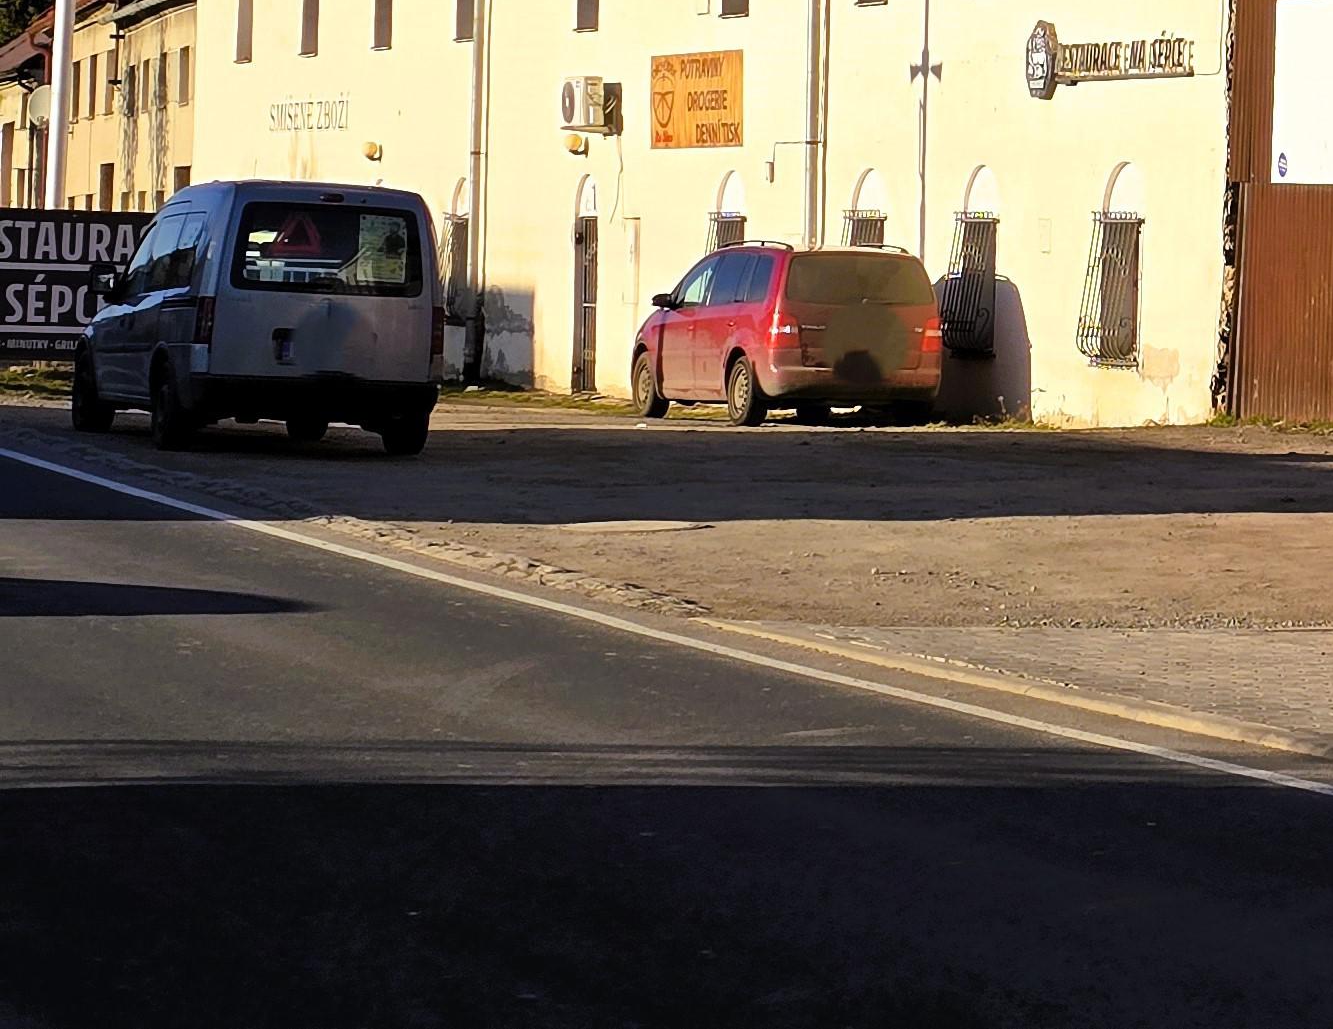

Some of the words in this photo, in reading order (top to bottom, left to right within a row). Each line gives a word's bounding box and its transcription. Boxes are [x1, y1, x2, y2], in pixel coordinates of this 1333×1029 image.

[316, 90, 349, 130] ZBOŽÍ
[687, 89, 728, 111] DROGERIE
[696, 118, 721, 144] DENNÍ
